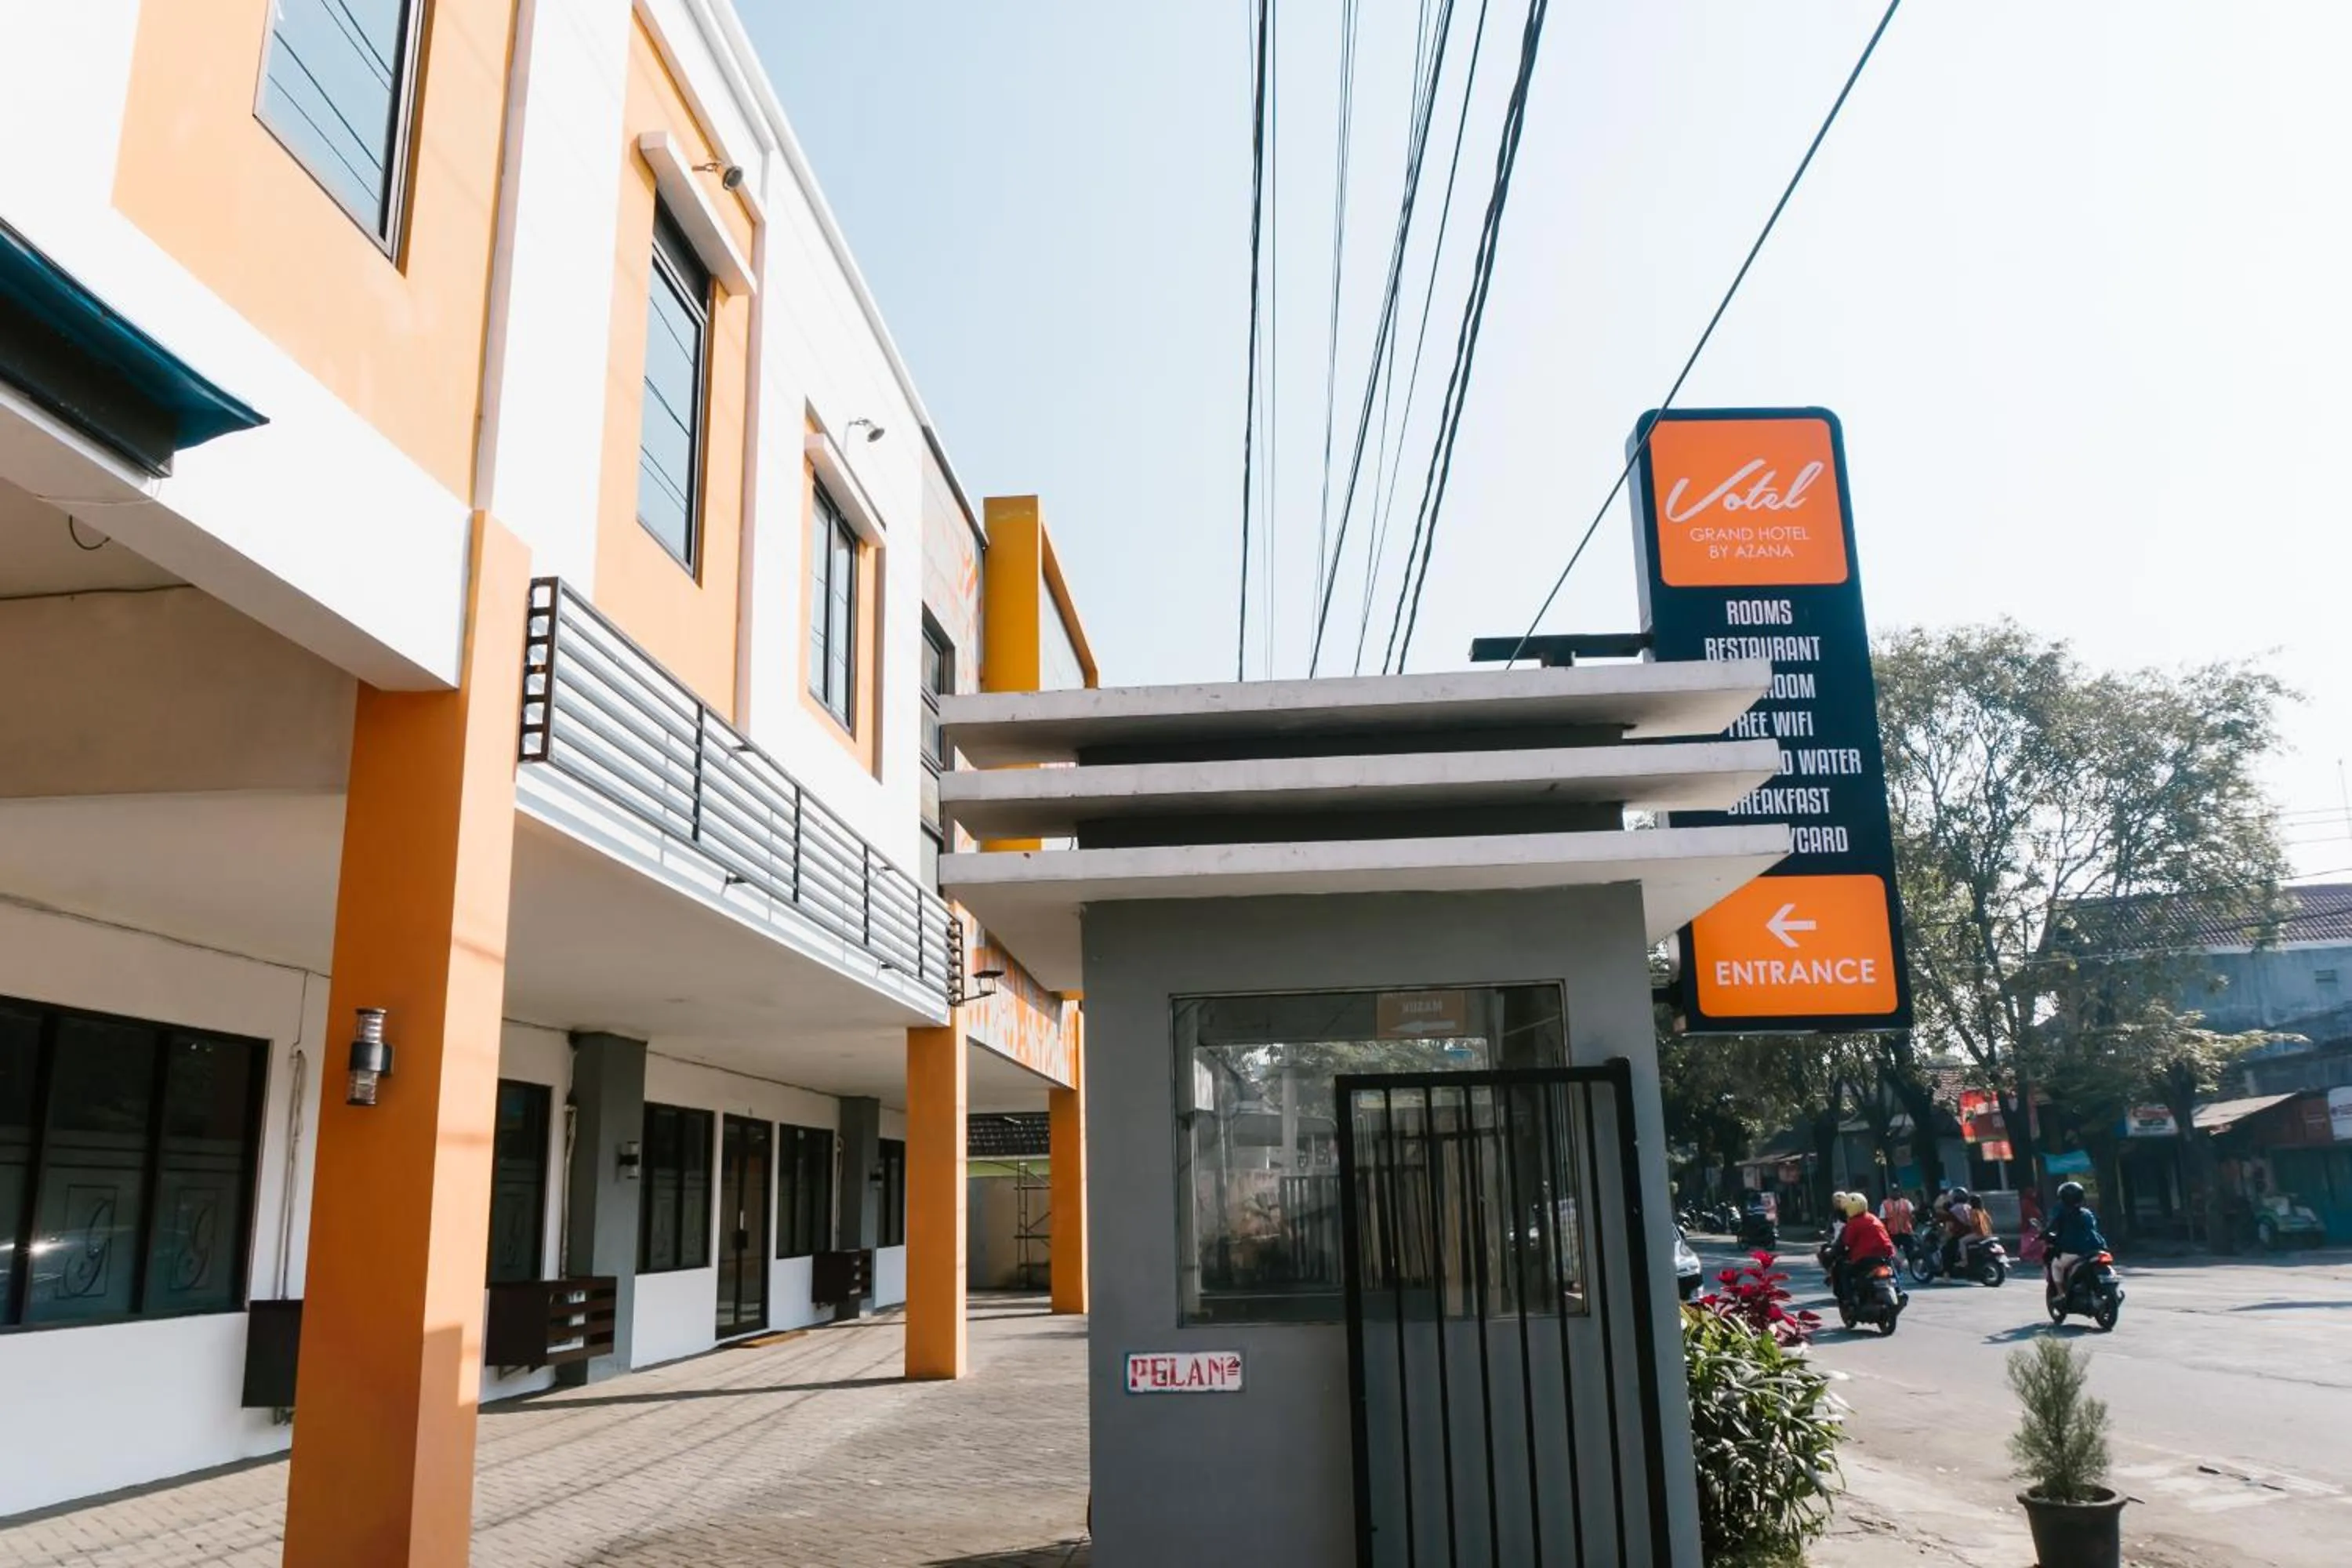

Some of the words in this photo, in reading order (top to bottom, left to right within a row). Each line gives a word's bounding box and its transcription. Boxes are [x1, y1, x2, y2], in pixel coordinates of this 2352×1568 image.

[1665, 458, 1824, 523] Votel
[1690, 527, 1754, 543] GRAND
[1759, 525, 1810, 541] HOTEL
[1709, 544, 1728, 559] BY
[1734, 543, 1794, 558] AZANA
[1726, 600, 1792, 625] ROOMS
[1704, 636, 1820, 661] RESTAURANT
[1773, 711, 1813, 736] WIFI
[1797, 749, 1862, 775] WATER
[1715, 958, 1877, 986] ENTRANCE
